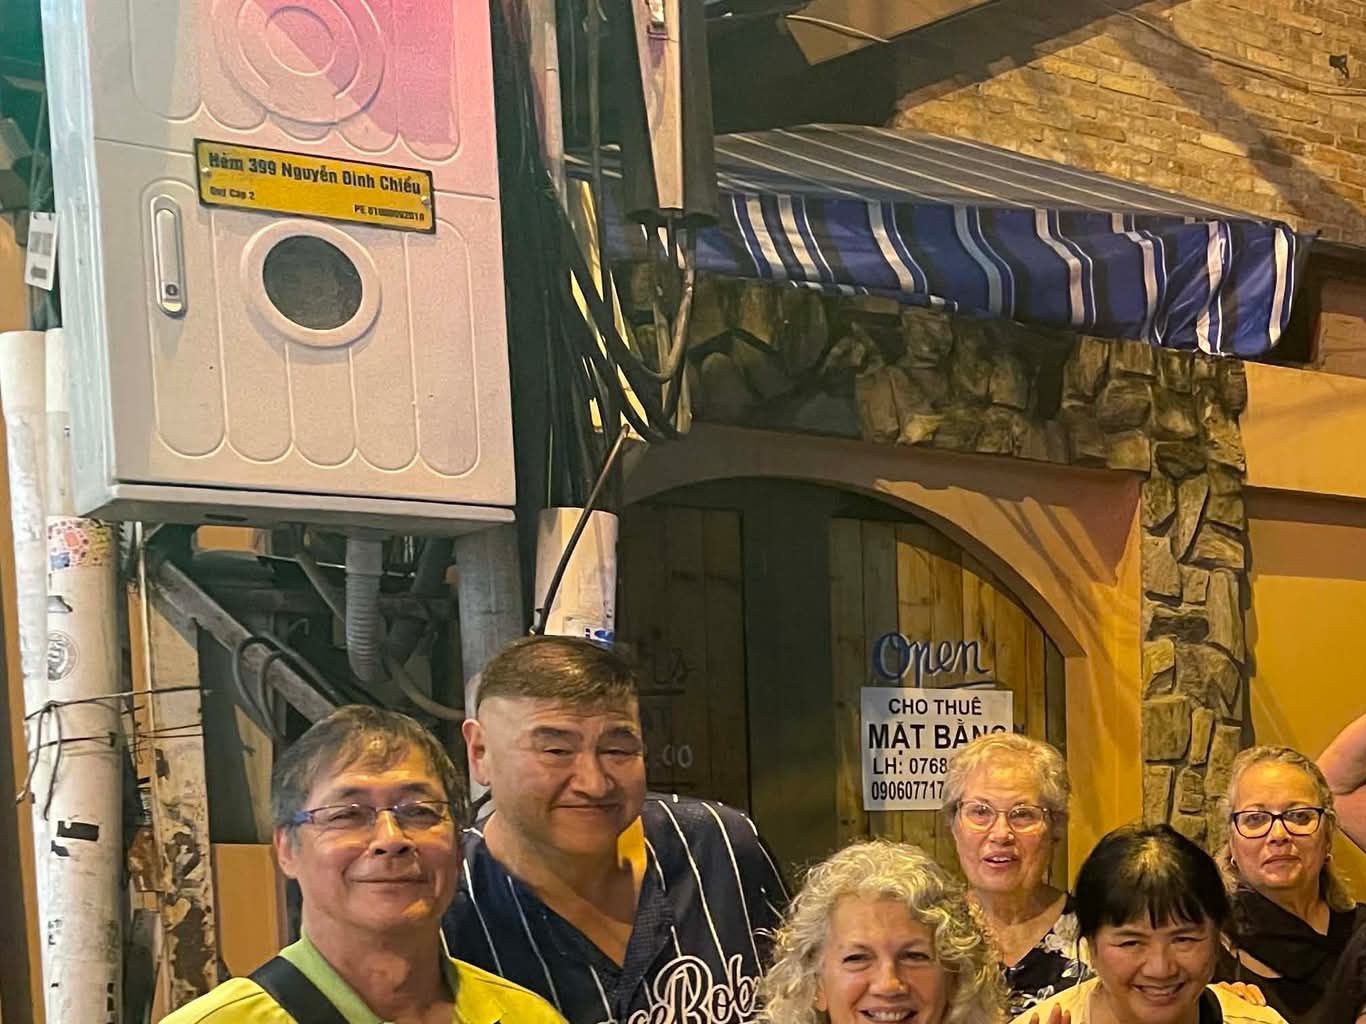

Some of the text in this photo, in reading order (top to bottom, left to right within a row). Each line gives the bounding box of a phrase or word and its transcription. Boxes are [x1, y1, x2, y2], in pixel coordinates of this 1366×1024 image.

[249, 158, 276, 175] 399
[873, 632, 993, 687] Open
[888, 697, 982, 716] CHO THUÊ
[868, 722, 925, 755] MẶT
[873, 758, 948, 775] LH: 0768
[871, 781, 945, 800] 090607717
